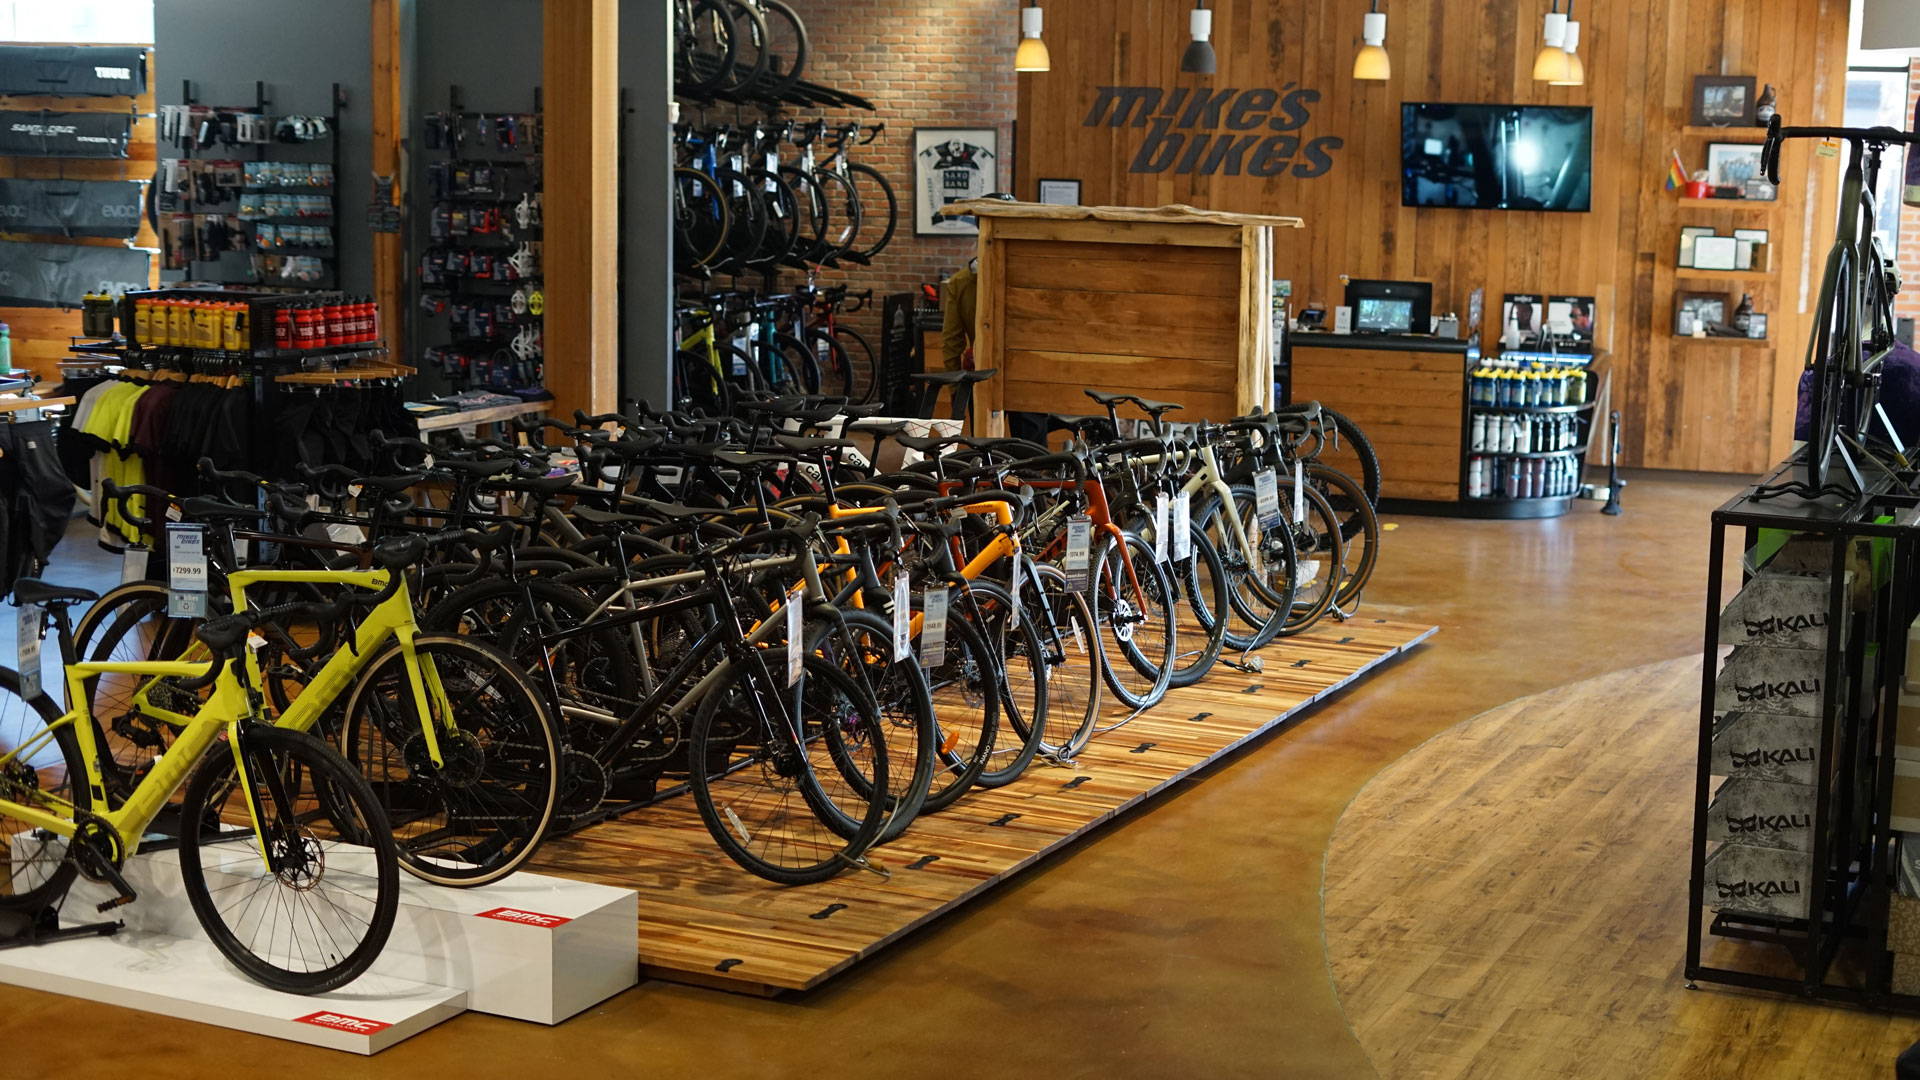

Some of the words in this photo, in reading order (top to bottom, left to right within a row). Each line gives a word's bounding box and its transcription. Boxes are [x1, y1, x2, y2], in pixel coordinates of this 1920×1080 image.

[1767, 678, 1821, 699] KALI
[1762, 746, 1816, 766] KALI
[1758, 813, 1811, 832] KALI
[1748, 879, 1801, 898] KALI
